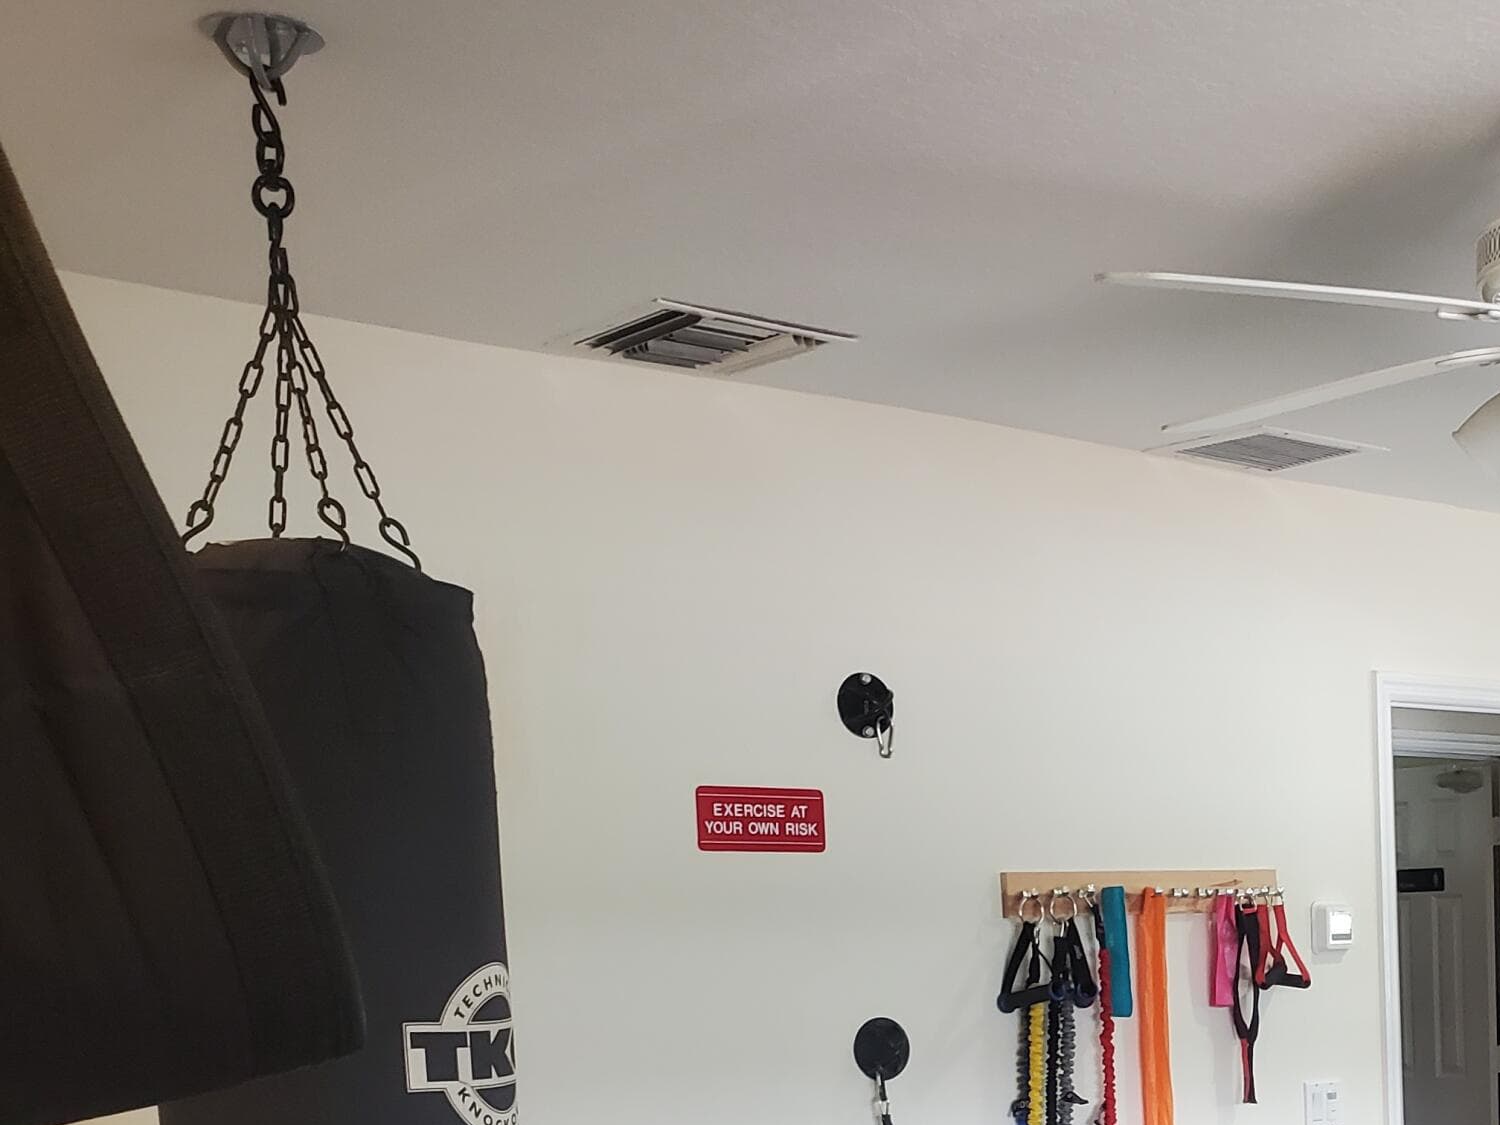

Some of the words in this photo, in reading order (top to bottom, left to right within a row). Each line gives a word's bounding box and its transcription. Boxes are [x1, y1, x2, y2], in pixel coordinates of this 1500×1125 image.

[712, 803, 786, 818] EXERCISE
[790, 805, 808, 819] AT
[704, 820, 743, 835] YOUR
[748, 821, 780, 836] OWN
[785, 822, 819, 836] RISK
[453, 973, 509, 1020] TECHNI
[409, 1026, 517, 1083] TK
